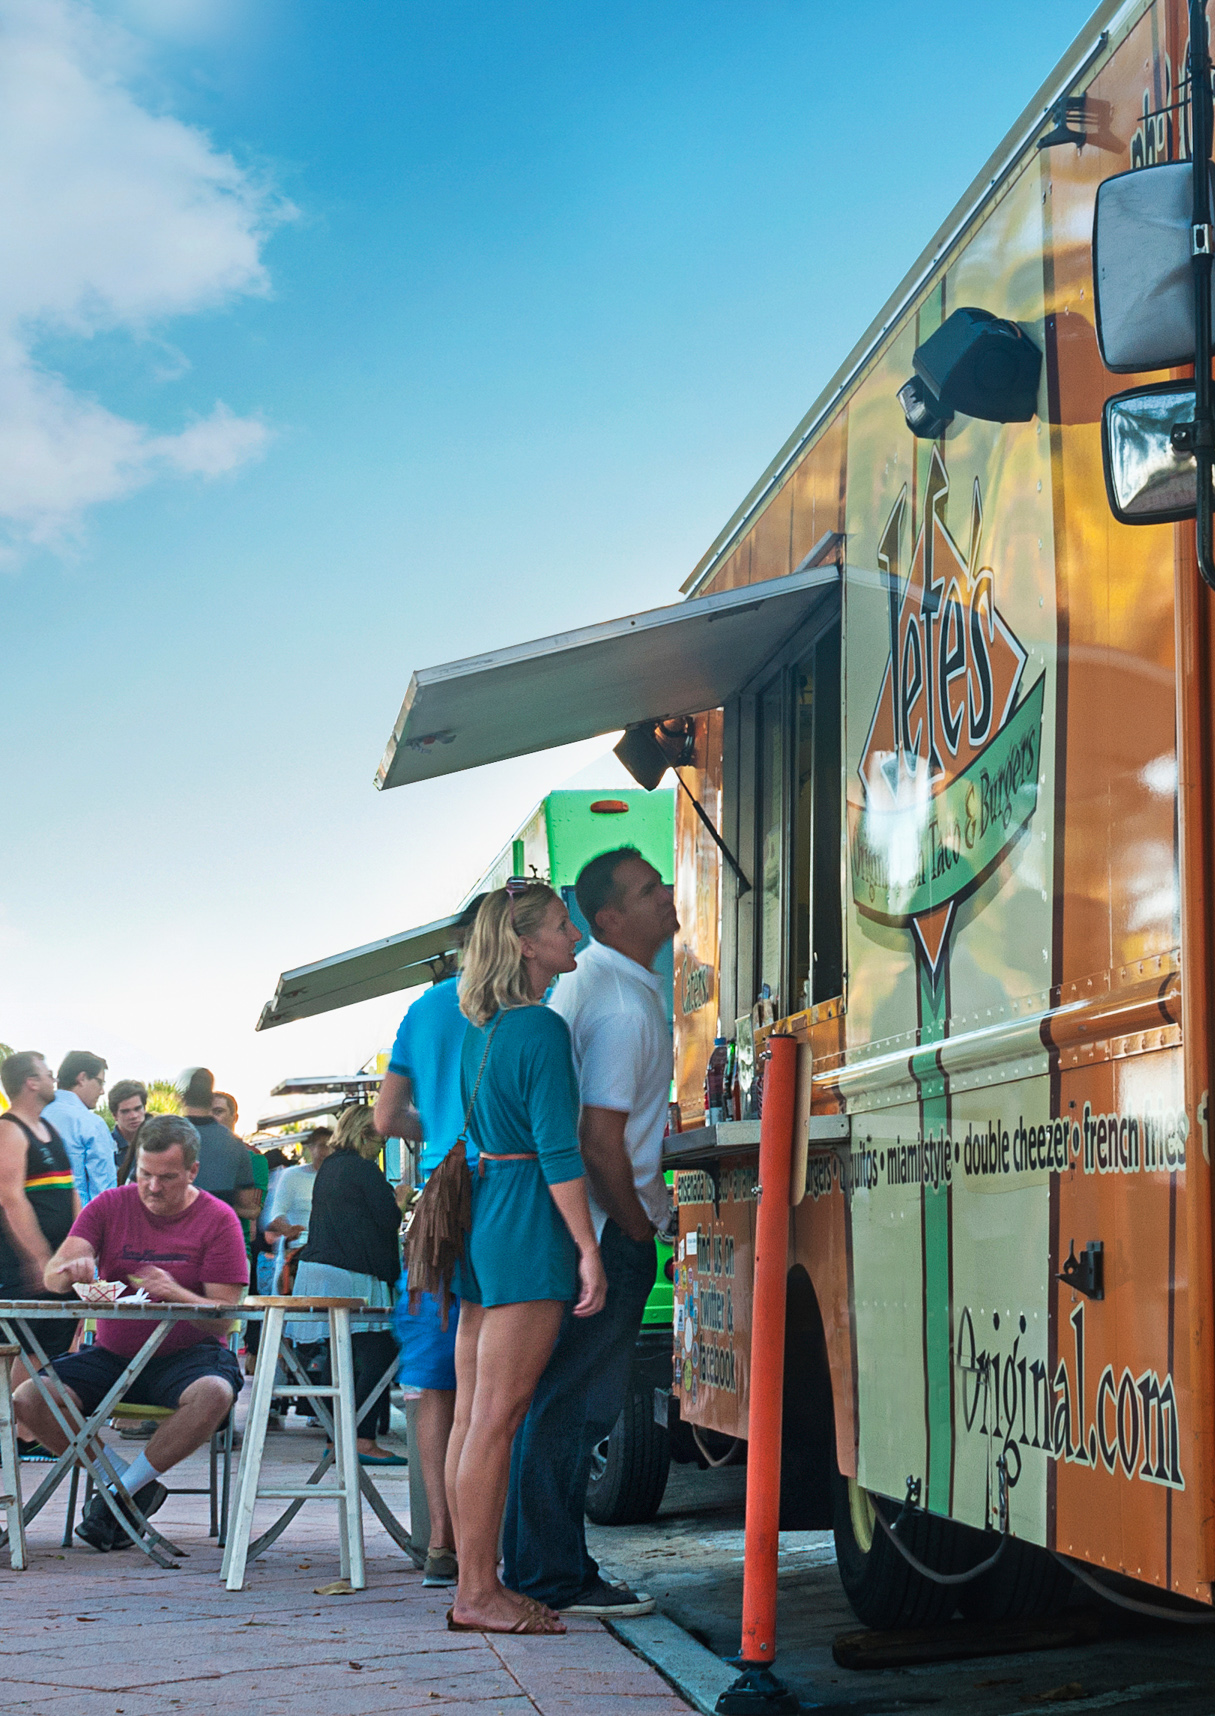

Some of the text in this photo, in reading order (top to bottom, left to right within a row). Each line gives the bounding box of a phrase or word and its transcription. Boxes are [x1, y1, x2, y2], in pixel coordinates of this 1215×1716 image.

[965, 782, 977, 849] &
[980, 725, 1036, 839] Burgers
[964, 1118, 1009, 1176] double
[1013, 1115, 1069, 1172] cheezer
[1084, 1102, 1140, 1171] french
[700, 1333, 736, 1393] facebook
[957, 1302, 1185, 1491] Original.com
